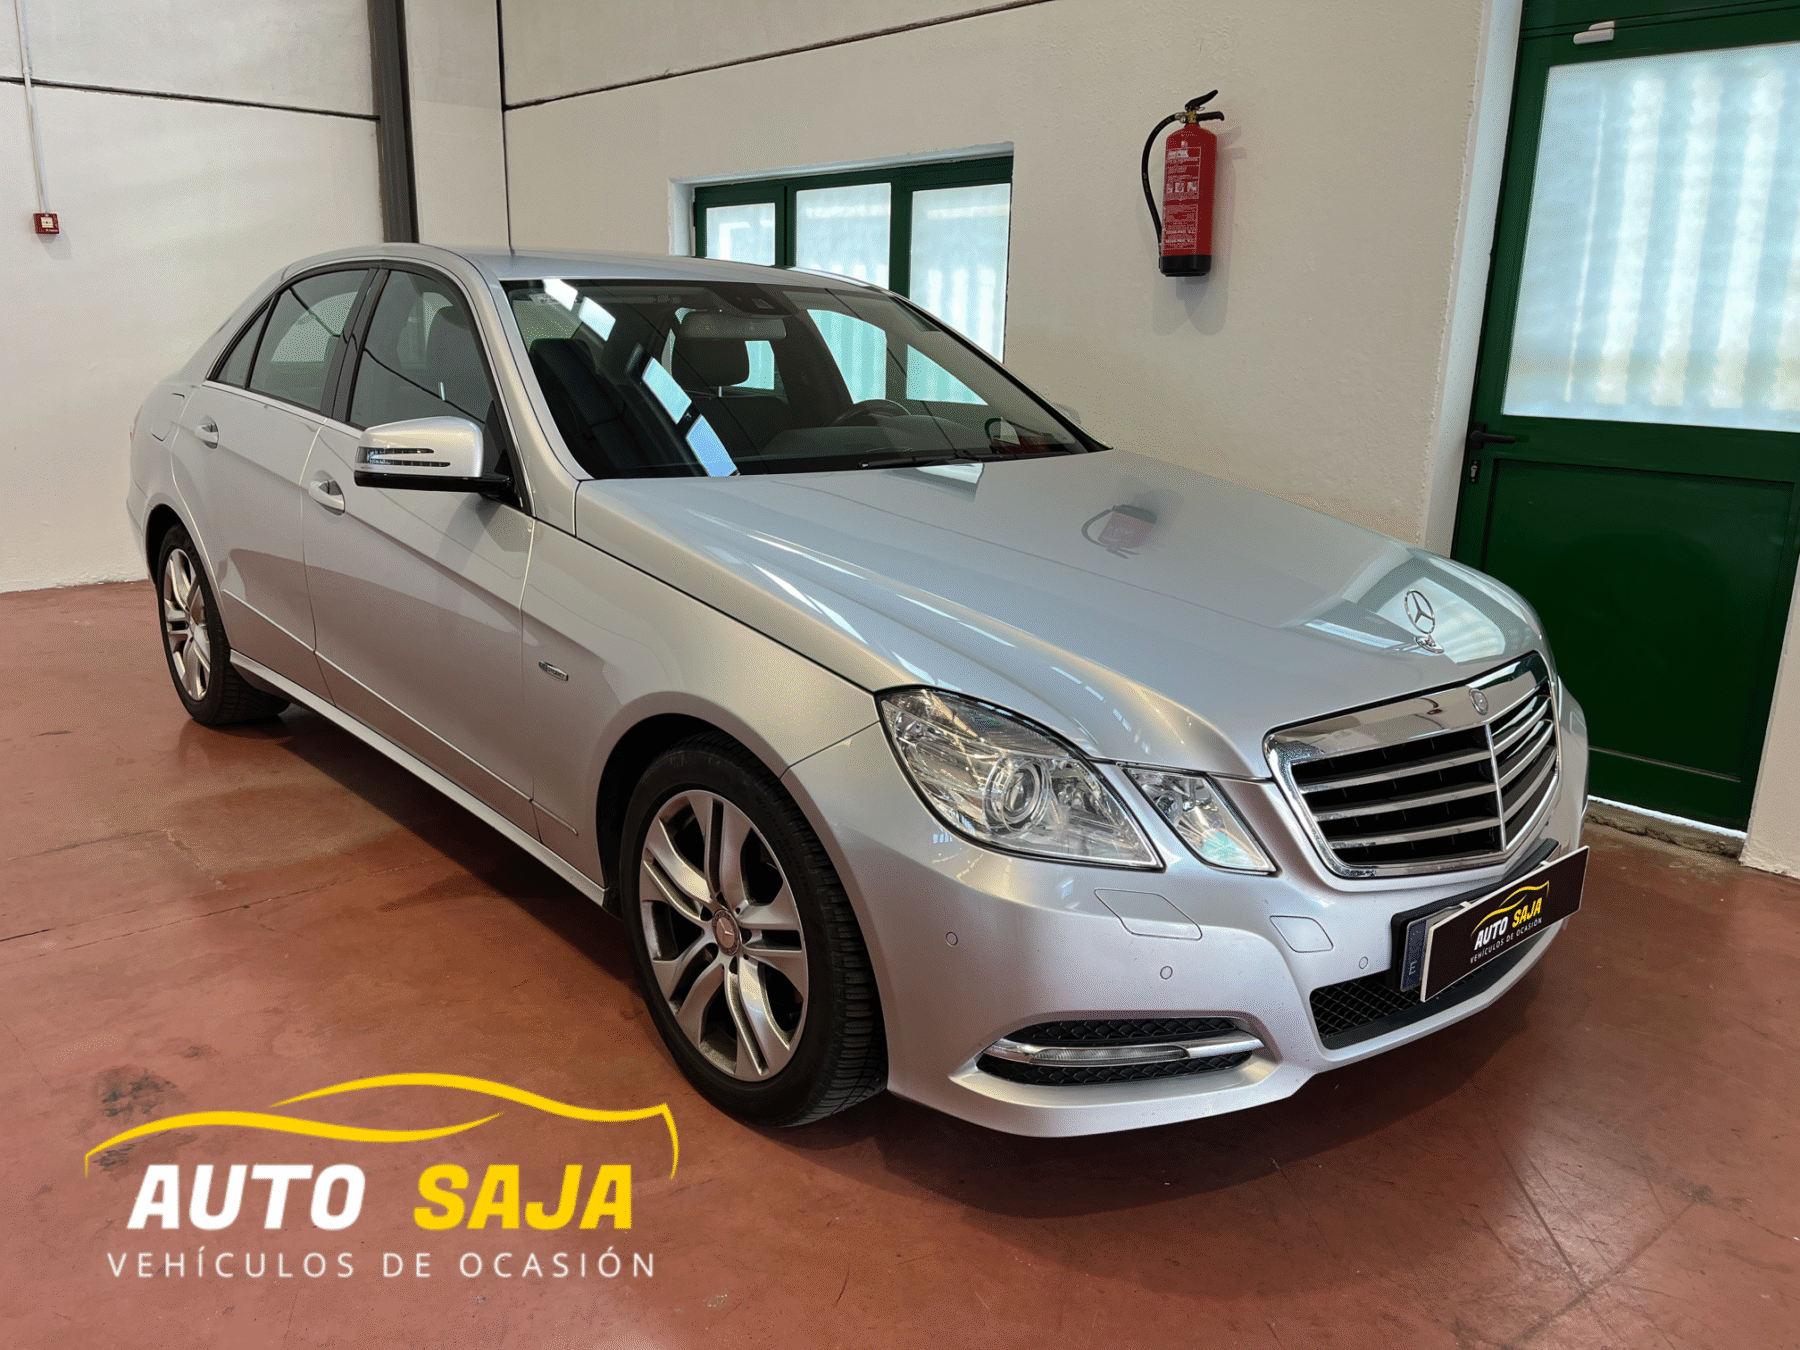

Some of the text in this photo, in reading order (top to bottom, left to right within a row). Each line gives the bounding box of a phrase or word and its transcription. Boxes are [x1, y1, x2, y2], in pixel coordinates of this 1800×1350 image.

[1470, 917, 1542, 964] VEHÍCULOS DE OCASIÓN
[1474, 897, 1543, 951] AUTO SAJA
